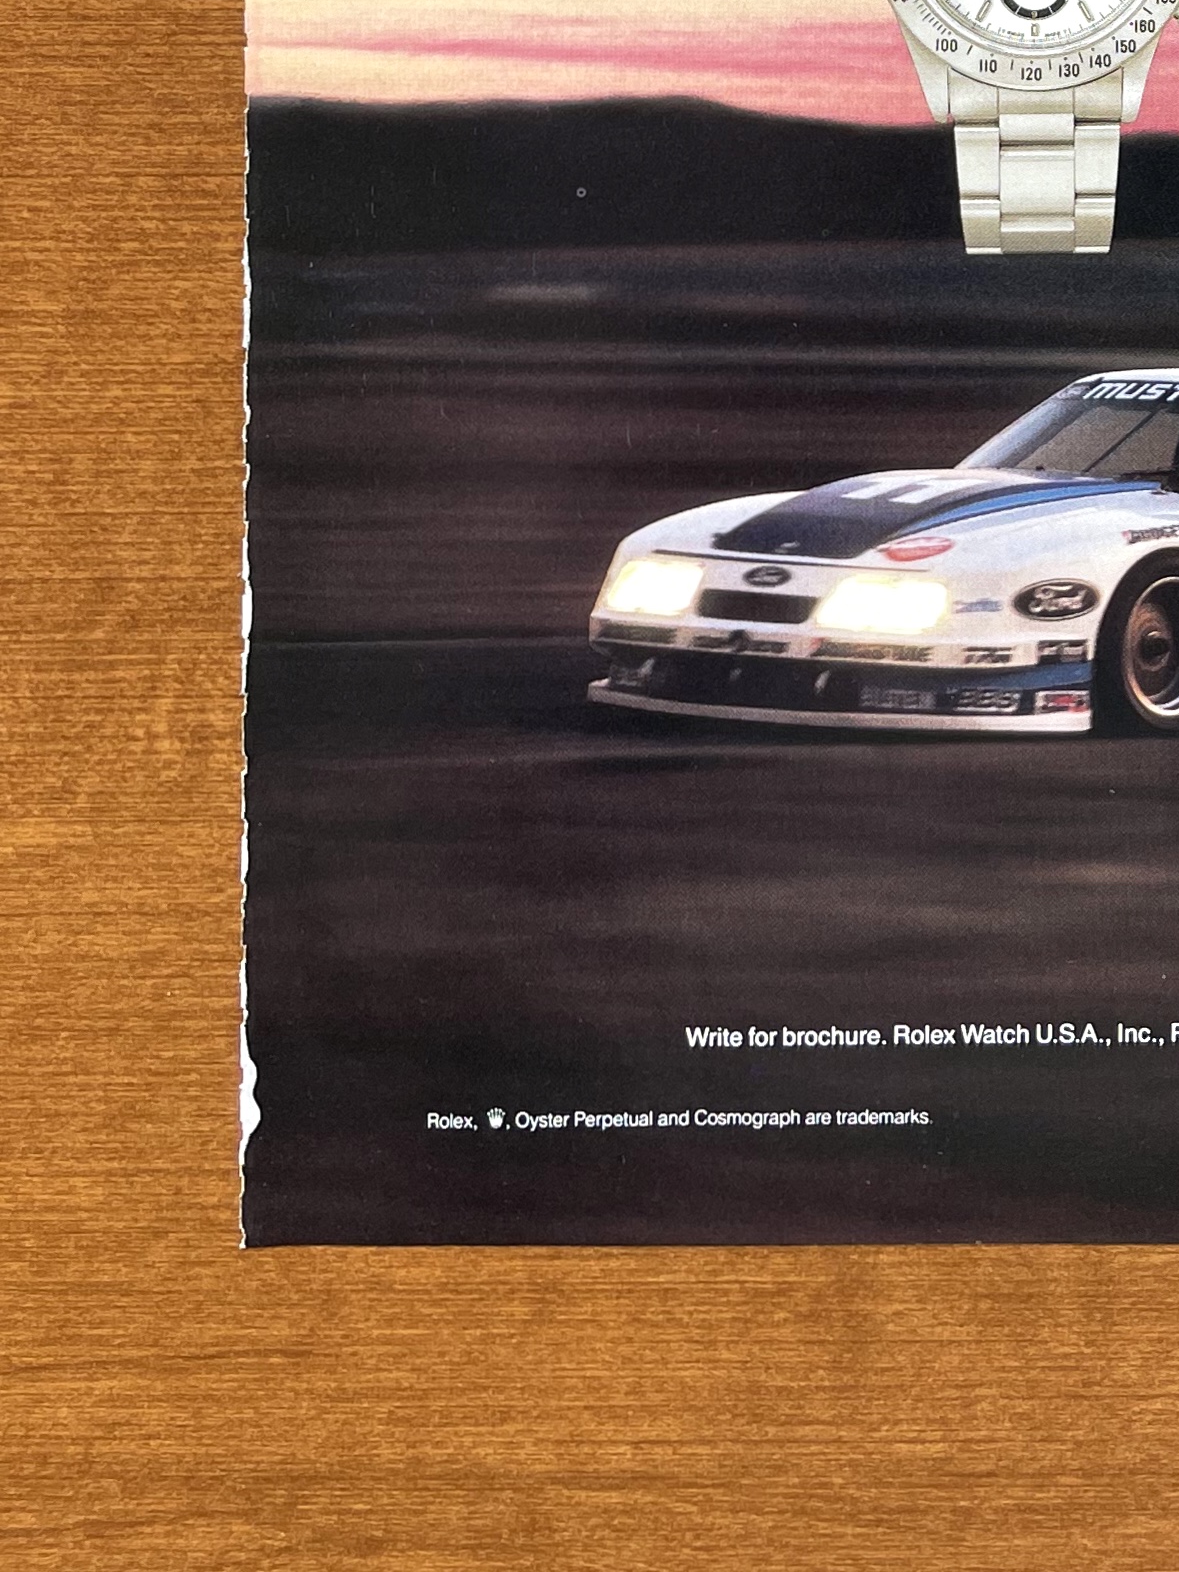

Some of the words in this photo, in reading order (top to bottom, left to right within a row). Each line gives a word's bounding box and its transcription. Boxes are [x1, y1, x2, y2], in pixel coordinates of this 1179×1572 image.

[1134, 19, 1156, 33] 160
[935, 39, 958, 52] 100
[1115, 39, 1137, 53] 150
[979, 59, 998, 73] 110
[1089, 54, 1112, 67] 140
[1020, 67, 1042, 81] 120
[1058, 64, 1080, 77] 130
[685, 1026, 744, 1048] Write
[747, 1025, 779, 1048] for
[782, 1025, 887, 1047] brochure.
[893, 1024, 957, 1046] Rolex
[960, 1023, 1030, 1045] Watch
[1035, 1022, 1112, 1047] U.S.A.,
[1117, 1022, 1165, 1047] Inc.,
[426, 1111, 479, 1132] Rolex,
[514, 1110, 571, 1133] Oyster
[573, 1109, 654, 1132] Perpetual
[656, 1109, 690, 1127] and
[693, 1108, 801, 1130] Cosmograph
[804, 1111, 833, 1126] are
[835, 1108, 934, 1126] trademarks.
